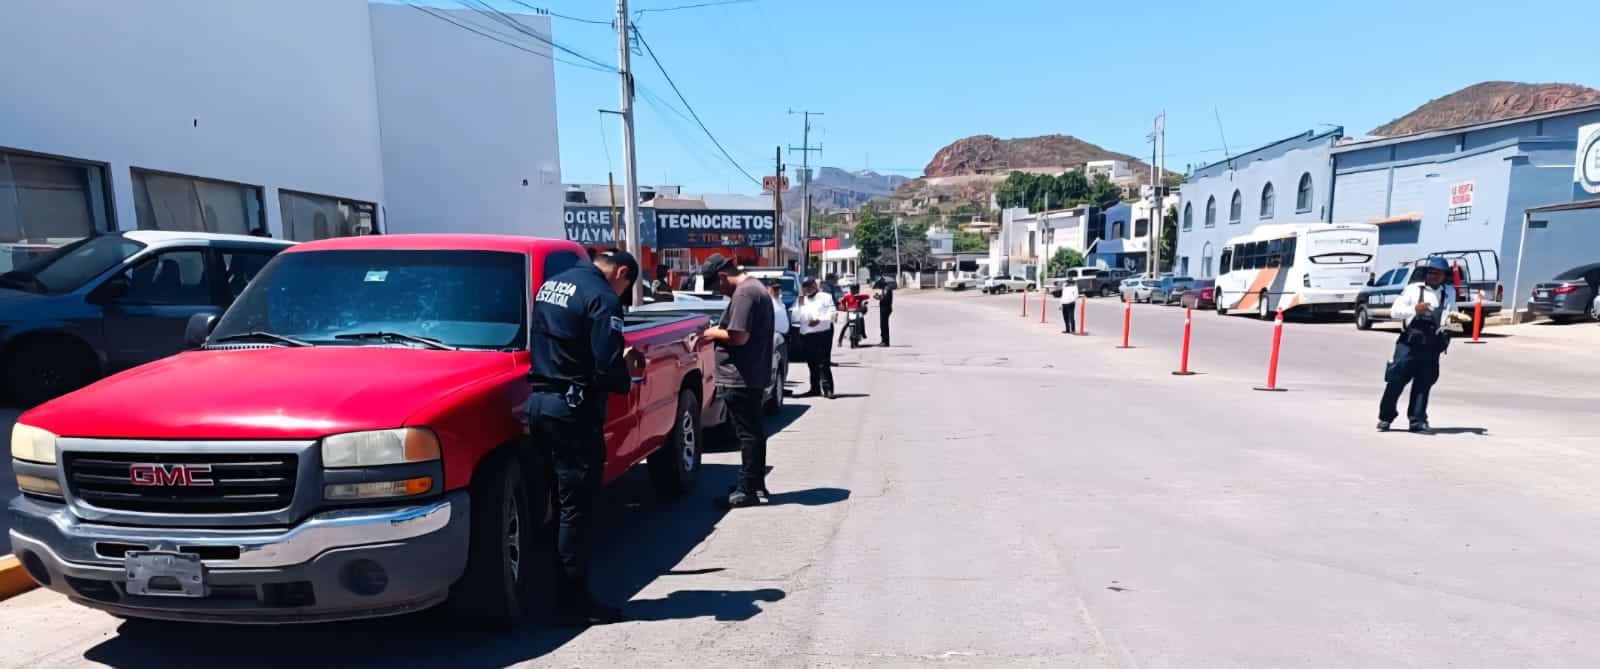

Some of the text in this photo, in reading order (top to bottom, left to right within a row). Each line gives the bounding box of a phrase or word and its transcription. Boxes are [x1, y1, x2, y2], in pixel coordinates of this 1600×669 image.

[658, 214, 774, 229] TECNOCRETOS
[535, 290, 569, 308] ESTATAL
[130, 463, 214, 486] GMC
